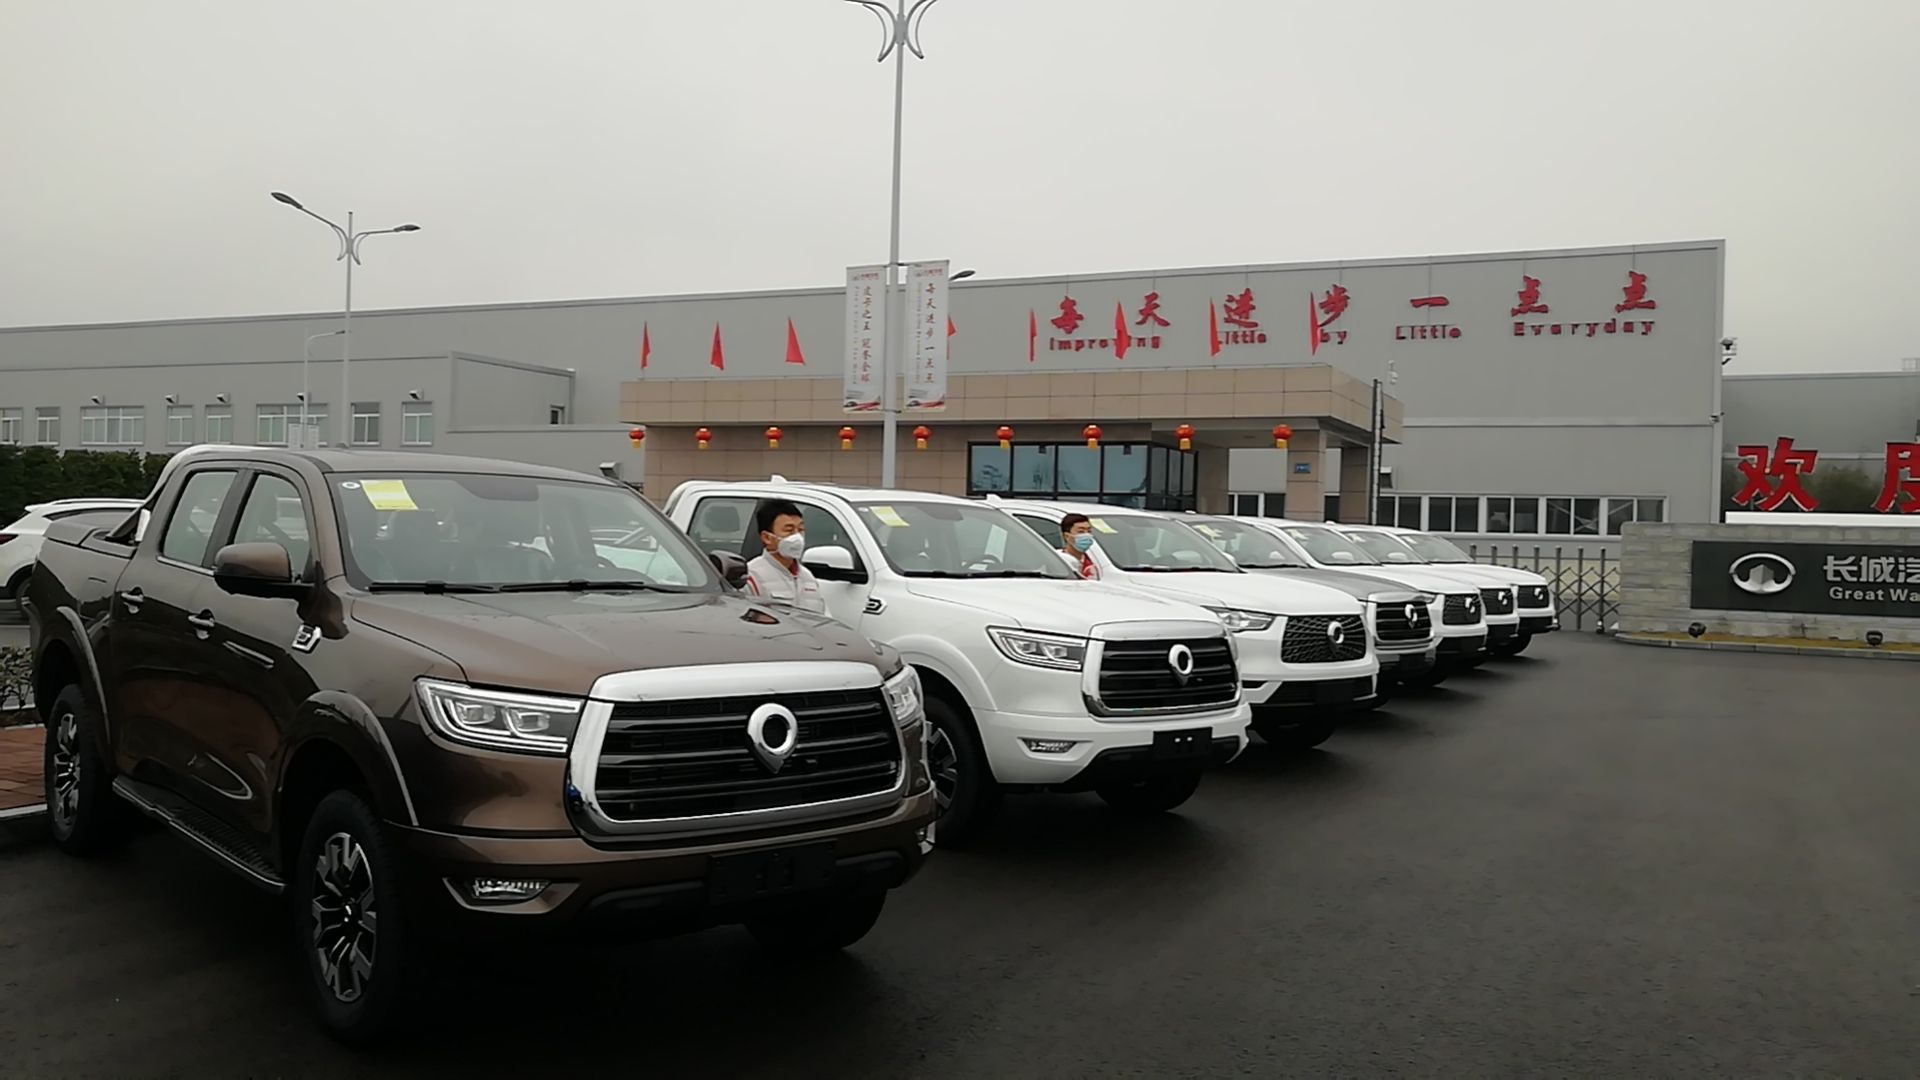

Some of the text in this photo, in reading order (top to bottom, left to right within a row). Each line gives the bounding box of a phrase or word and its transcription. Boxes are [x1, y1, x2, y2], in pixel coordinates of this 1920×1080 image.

[1050, 318, 1656, 352] Improing ittle by Little Everyday
[1829, 586, 1885, 601] Great
